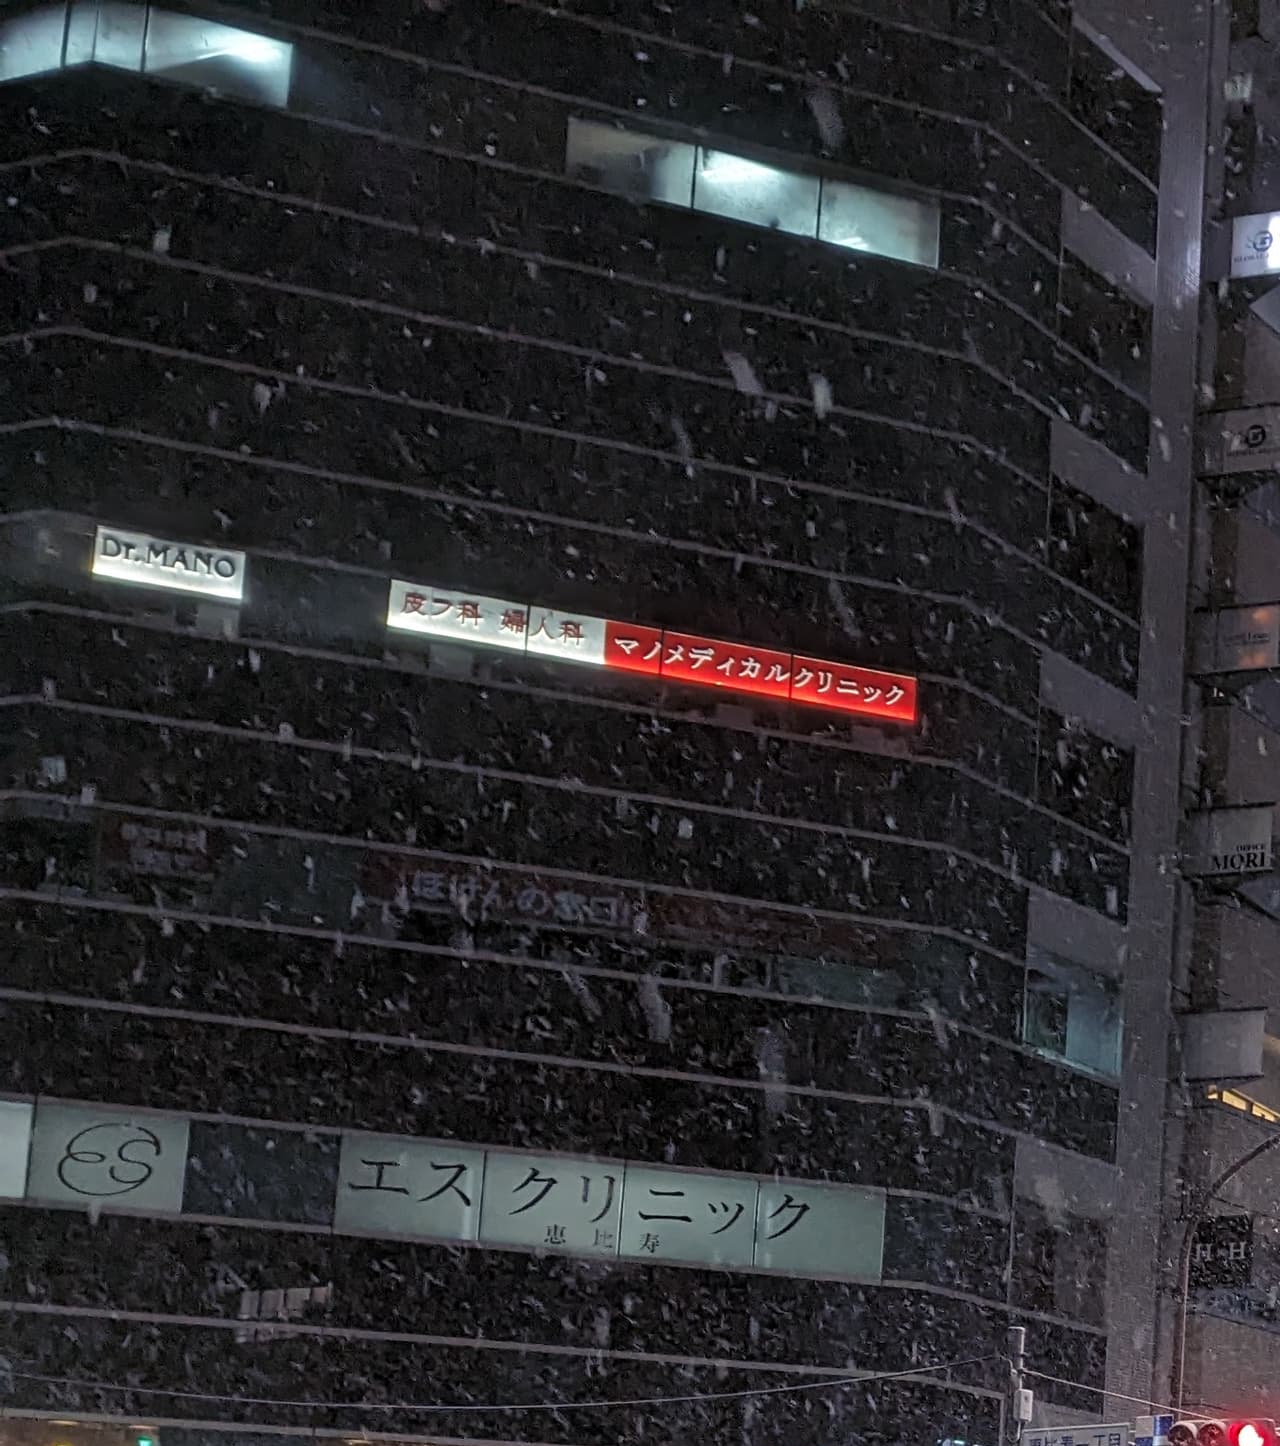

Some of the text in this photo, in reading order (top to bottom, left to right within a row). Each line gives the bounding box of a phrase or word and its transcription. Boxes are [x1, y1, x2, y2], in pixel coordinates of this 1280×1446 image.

[102, 537, 235, 578] Dr.MANO
[402, 592, 585, 646] 皮フ科 婦人科
[614, 636, 905, 706] マノメディカルクリニック
[1211, 852, 1265, 871] MORI
[349, 1159, 810, 1240] エスクリニック
[544, 1223, 661, 1254] 恵比寿
